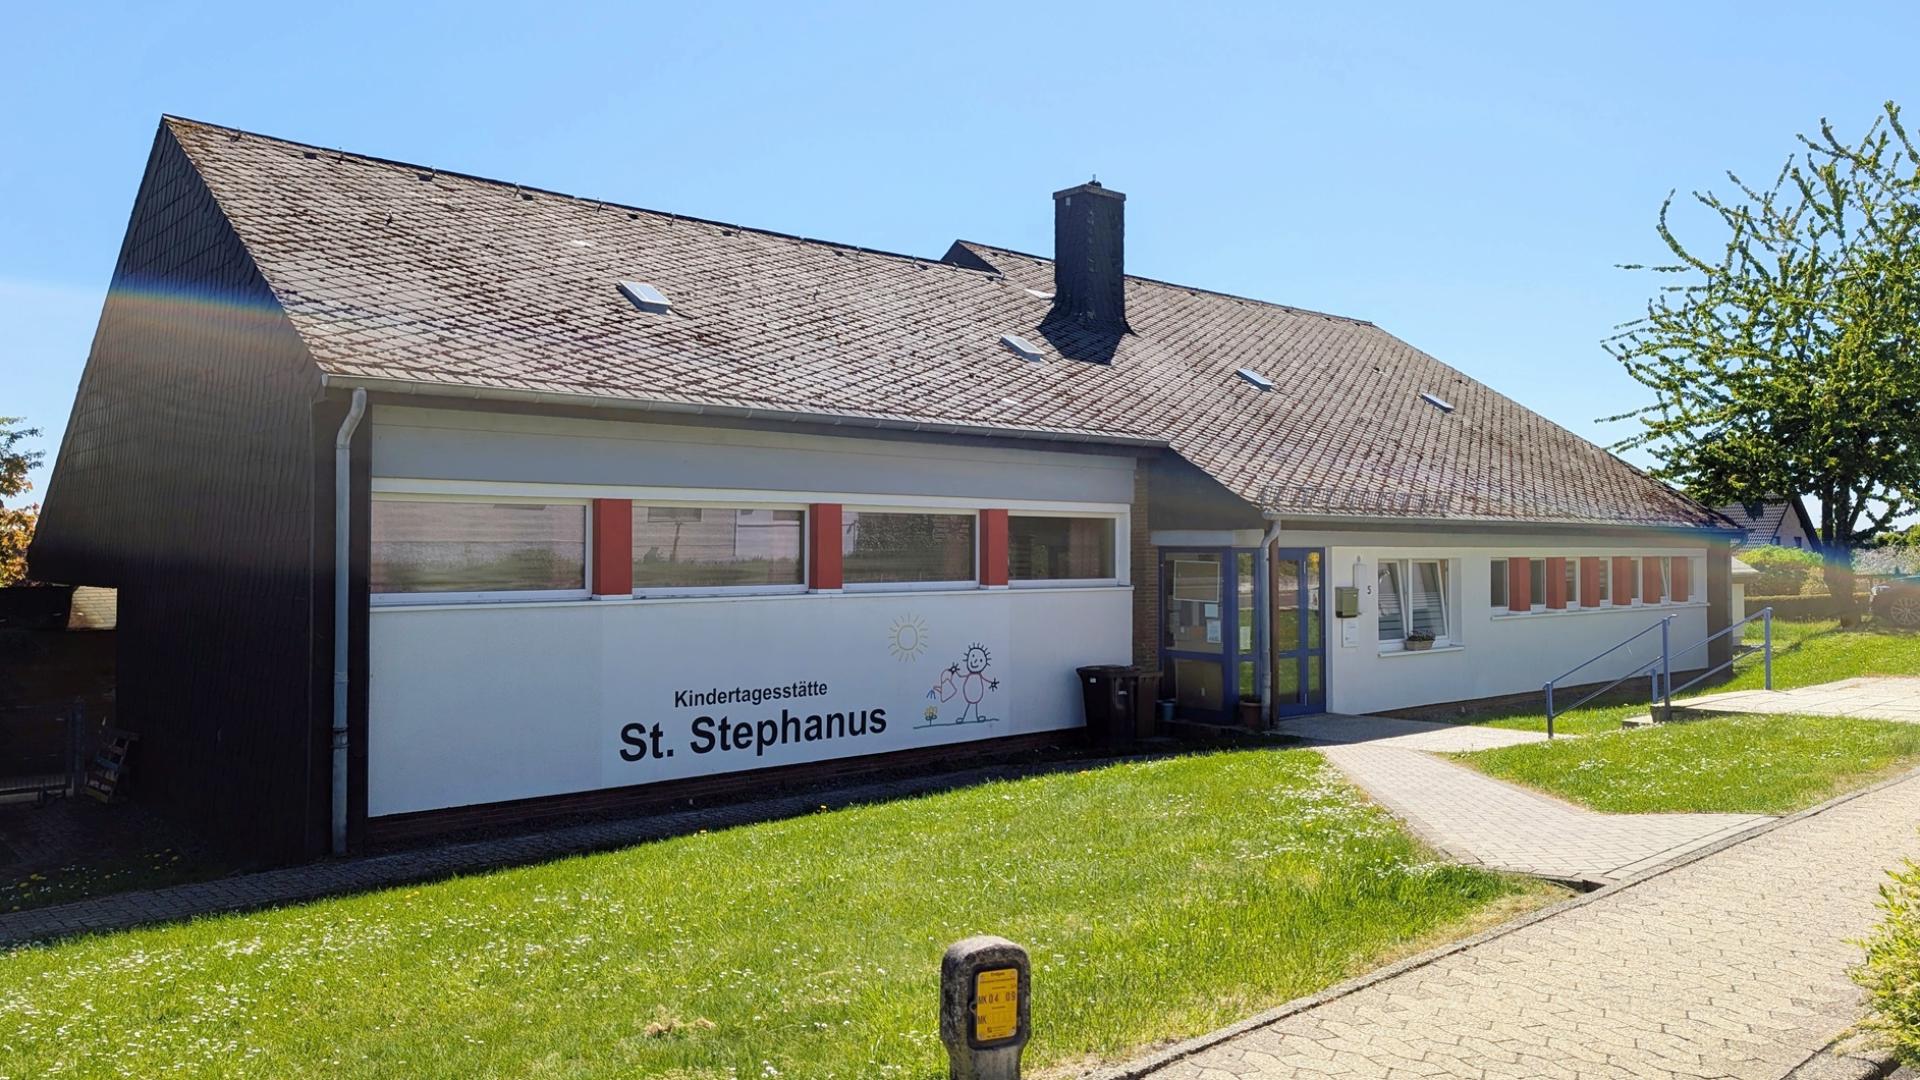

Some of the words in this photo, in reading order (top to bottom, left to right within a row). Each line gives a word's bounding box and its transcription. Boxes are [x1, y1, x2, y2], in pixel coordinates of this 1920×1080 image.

[1367, 585, 1372, 595] 5
[674, 680, 829, 709] Kindertagesstätte
[619, 721, 675, 763] St.
[689, 708, 887, 756] Stephanus
